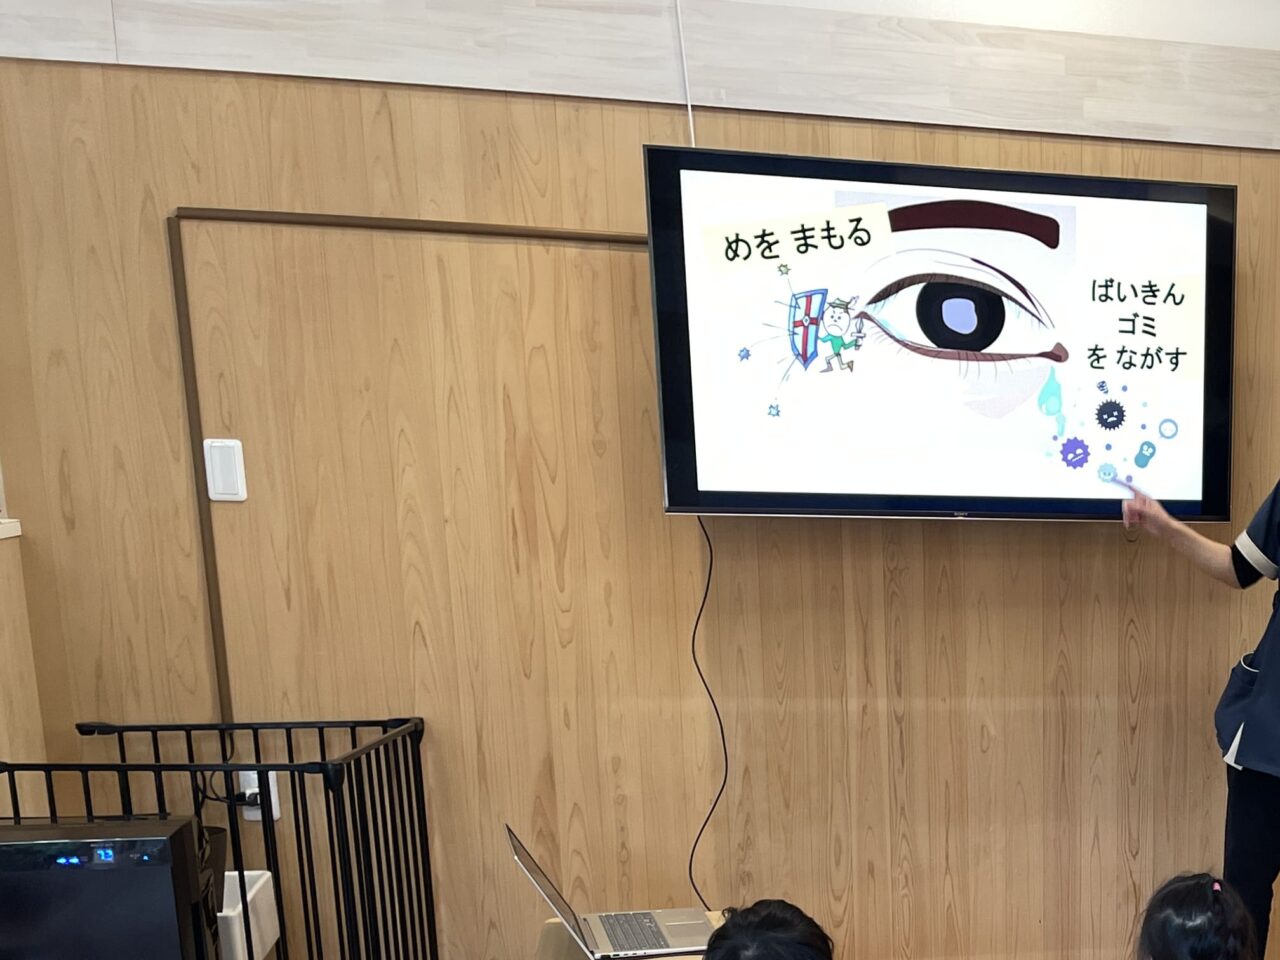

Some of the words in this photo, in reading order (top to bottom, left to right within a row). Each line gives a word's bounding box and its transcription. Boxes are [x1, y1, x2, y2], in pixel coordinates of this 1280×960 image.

[724, 228, 781, 262] めを
[790, 217, 873, 256] まもる
[1091, 278, 1186, 306] ばいきん
[1117, 312, 1158, 338] ゴミ
[1087, 344, 1108, 370] を
[1116, 345, 1188, 372] ながす
